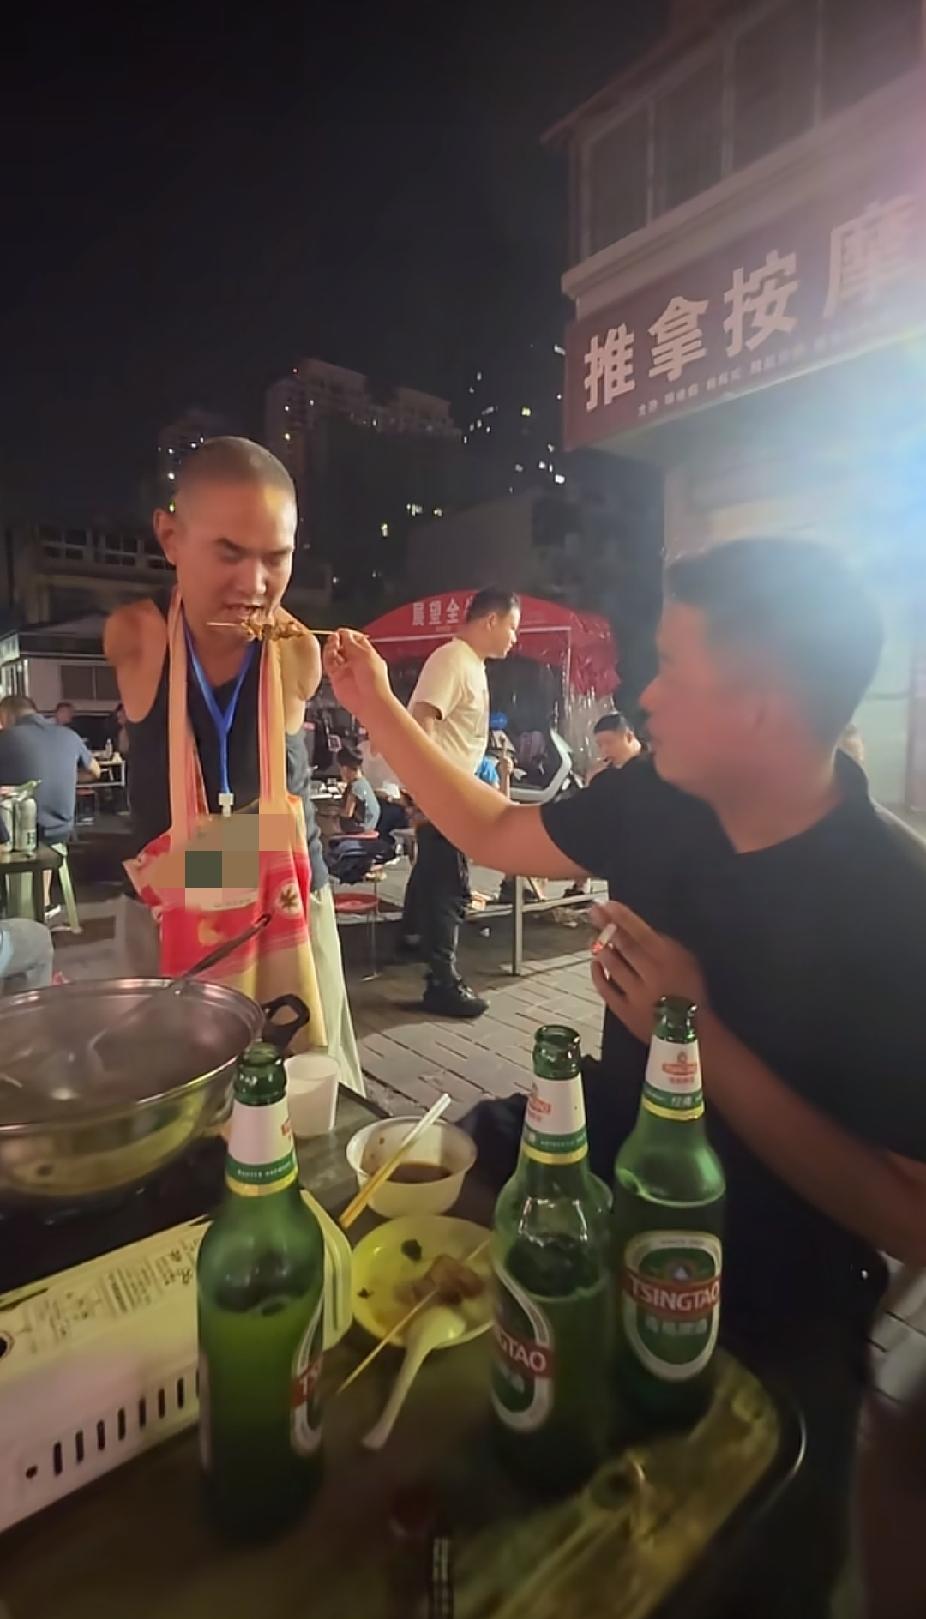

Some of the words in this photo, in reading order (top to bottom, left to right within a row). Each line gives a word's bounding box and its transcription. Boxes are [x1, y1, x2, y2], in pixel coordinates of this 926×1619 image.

[585, 194, 915, 411] 推拿按摩
[628, 1273, 720, 1312] TSINGTAO
